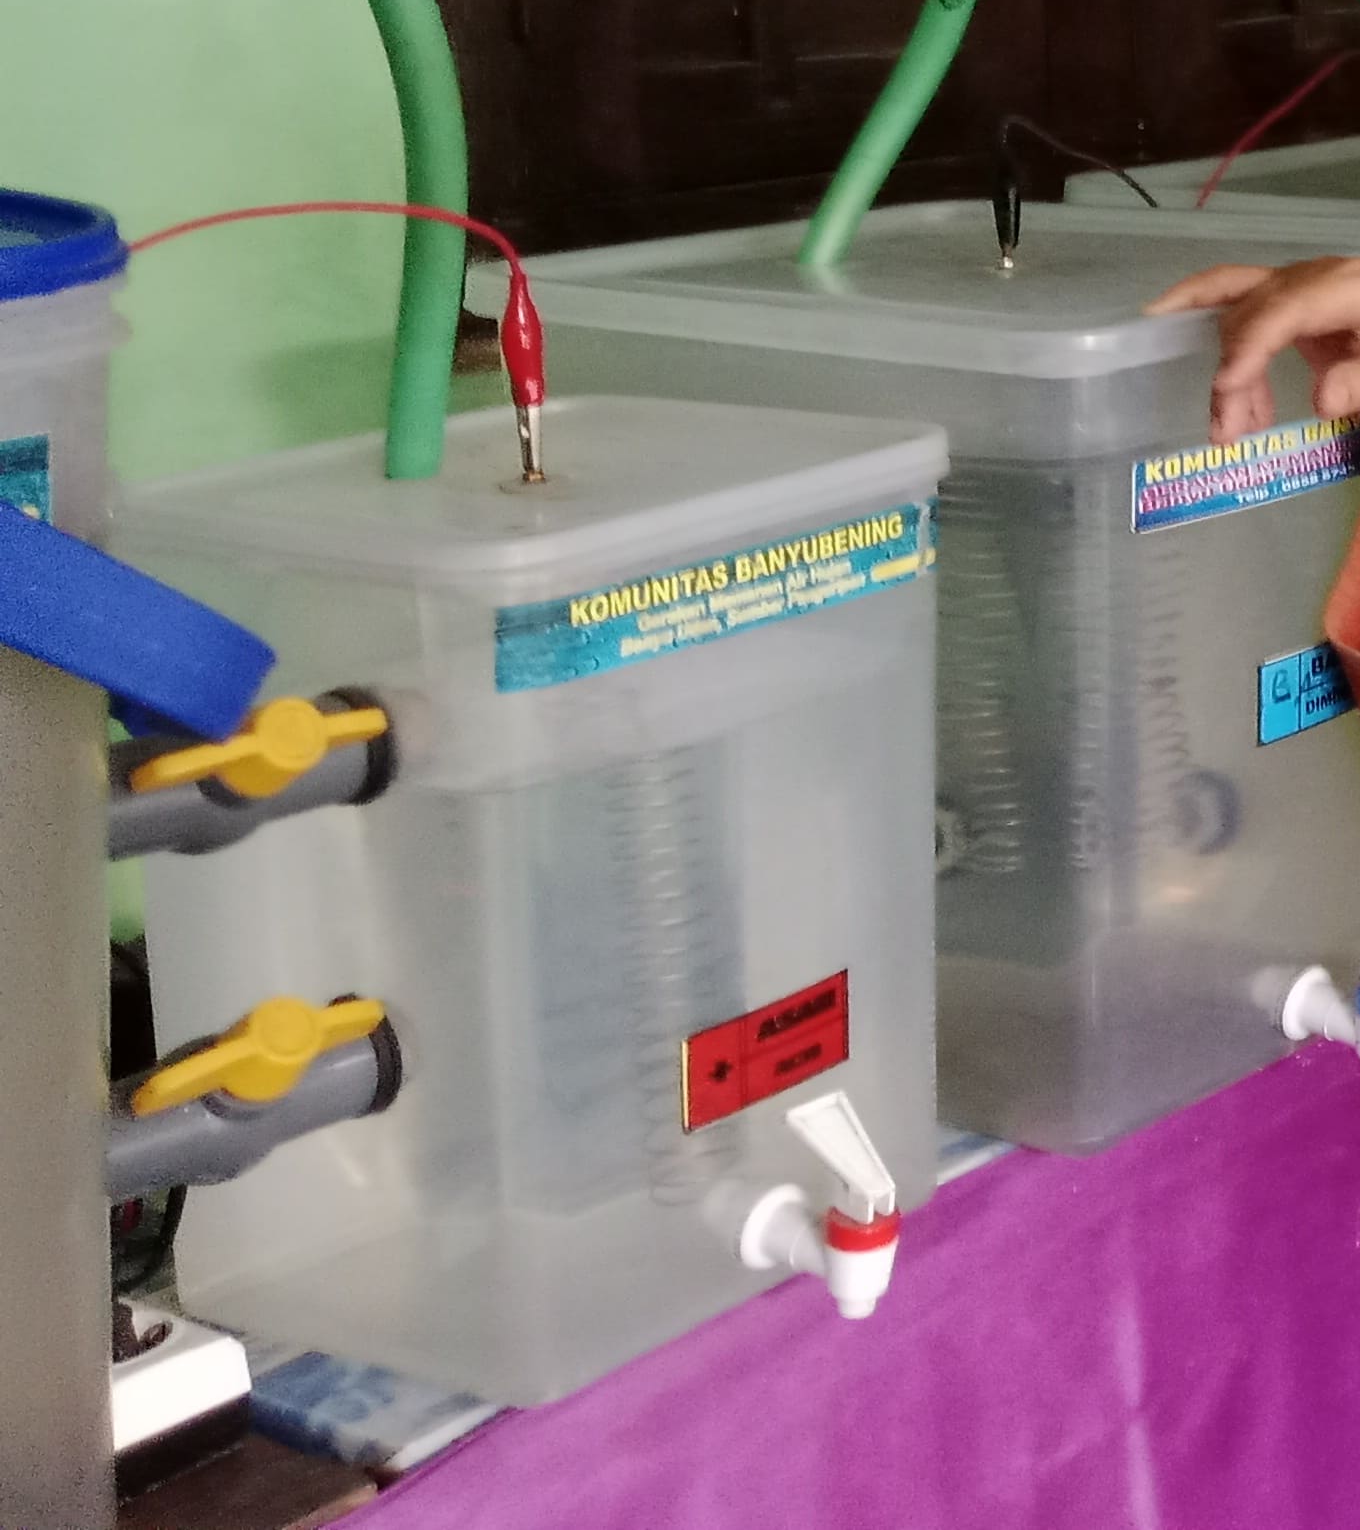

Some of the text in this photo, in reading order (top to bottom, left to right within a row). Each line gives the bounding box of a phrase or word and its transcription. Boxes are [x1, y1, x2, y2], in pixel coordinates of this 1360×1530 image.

[1145, 427, 1298, 486] KOMUNITAS
[570, 566, 729, 628] KOMUNITAS
[735, 511, 905, 584] BANYUBENING
